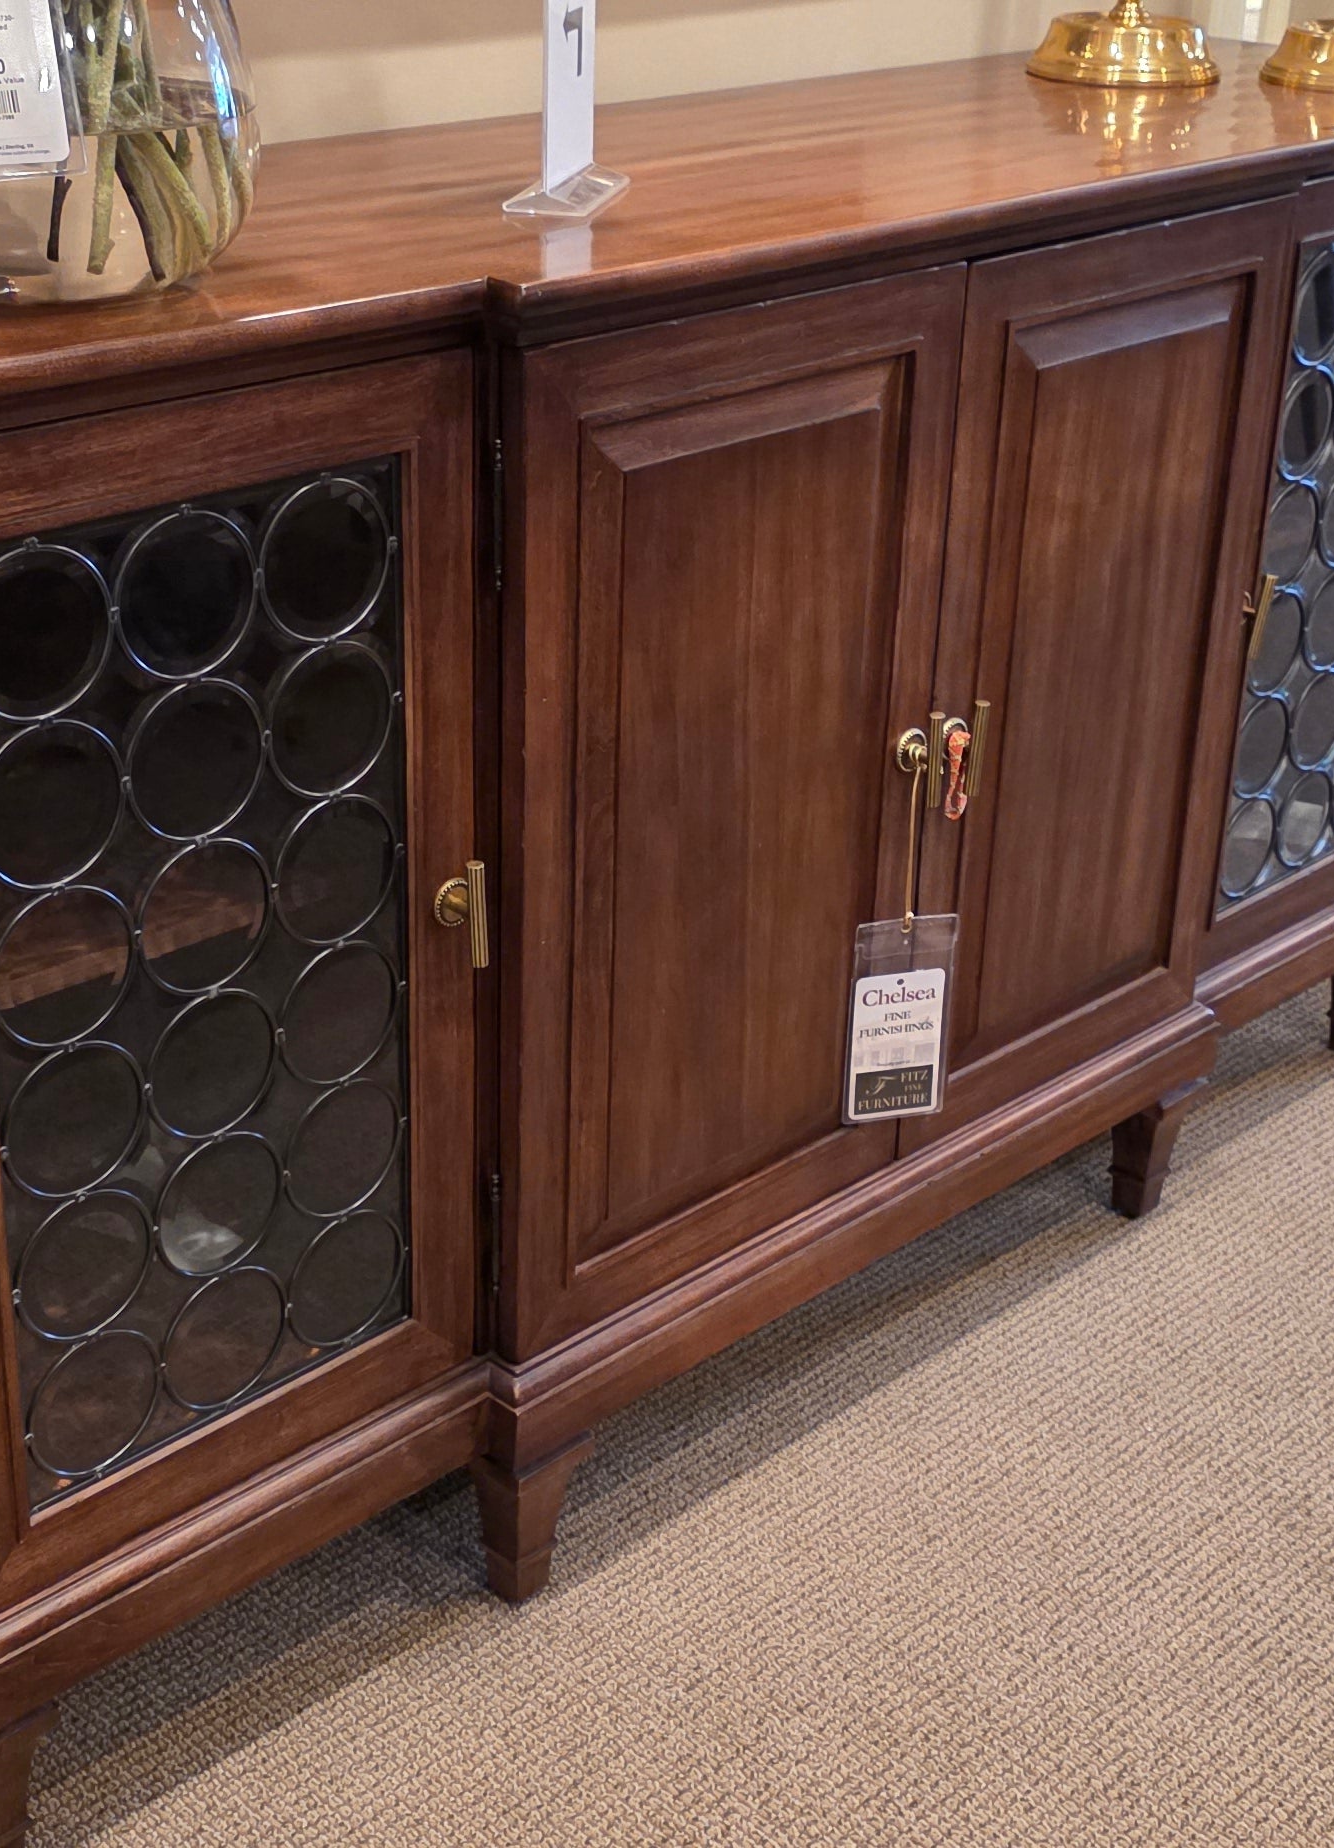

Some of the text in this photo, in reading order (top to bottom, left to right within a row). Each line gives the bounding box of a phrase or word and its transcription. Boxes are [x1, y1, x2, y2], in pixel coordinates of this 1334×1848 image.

[3, 76, 25, 84] Value
[862, 986, 936, 1007] Chelsea
[884, 1010, 911, 1022] FINE
[859, 1021, 935, 1039] FURNISHINGS
[900, 1069, 929, 1083] FITZ
[904, 1083, 923, 1094] FINE
[858, 1093, 929, 1111] FURNITURE
